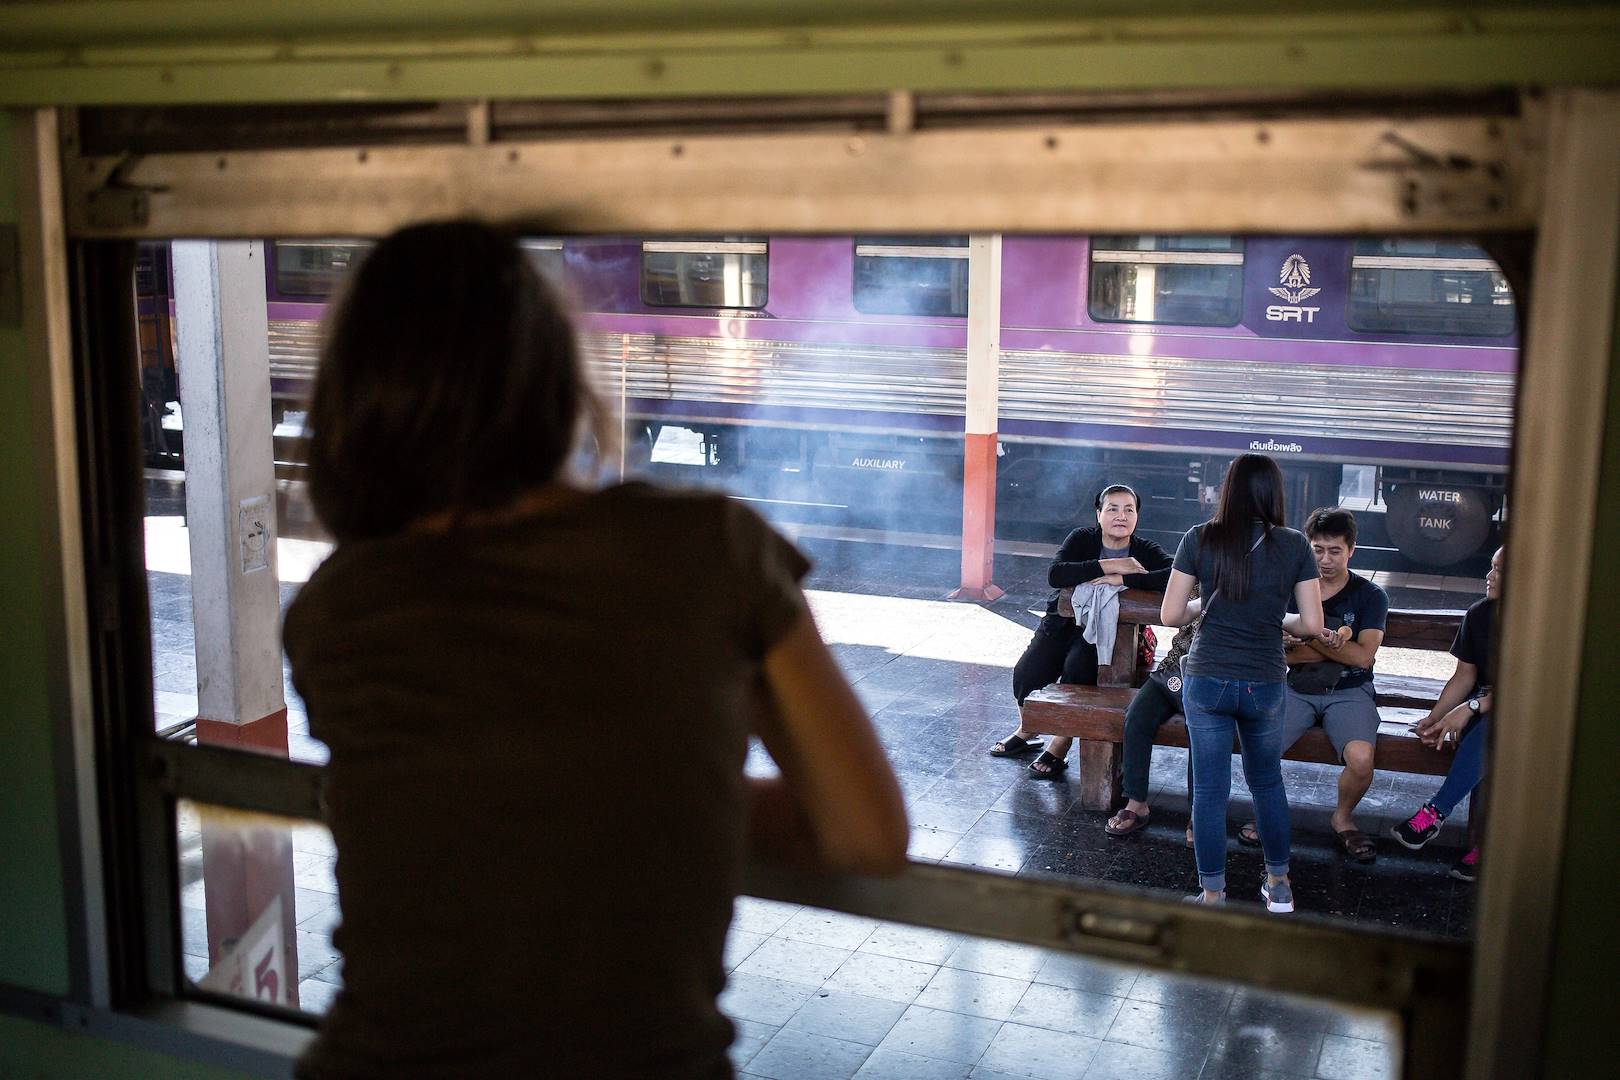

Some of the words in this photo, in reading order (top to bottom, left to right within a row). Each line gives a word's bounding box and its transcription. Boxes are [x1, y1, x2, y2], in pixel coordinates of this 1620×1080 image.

[1266, 305, 1320, 323] SRT
[1250, 439, 1302, 452] เติมเชื้อเพลิง
[852, 457, 905, 469] AUXILIARY
[1419, 489, 1460, 502] WATER
[1420, 517, 1451, 529] TANK
